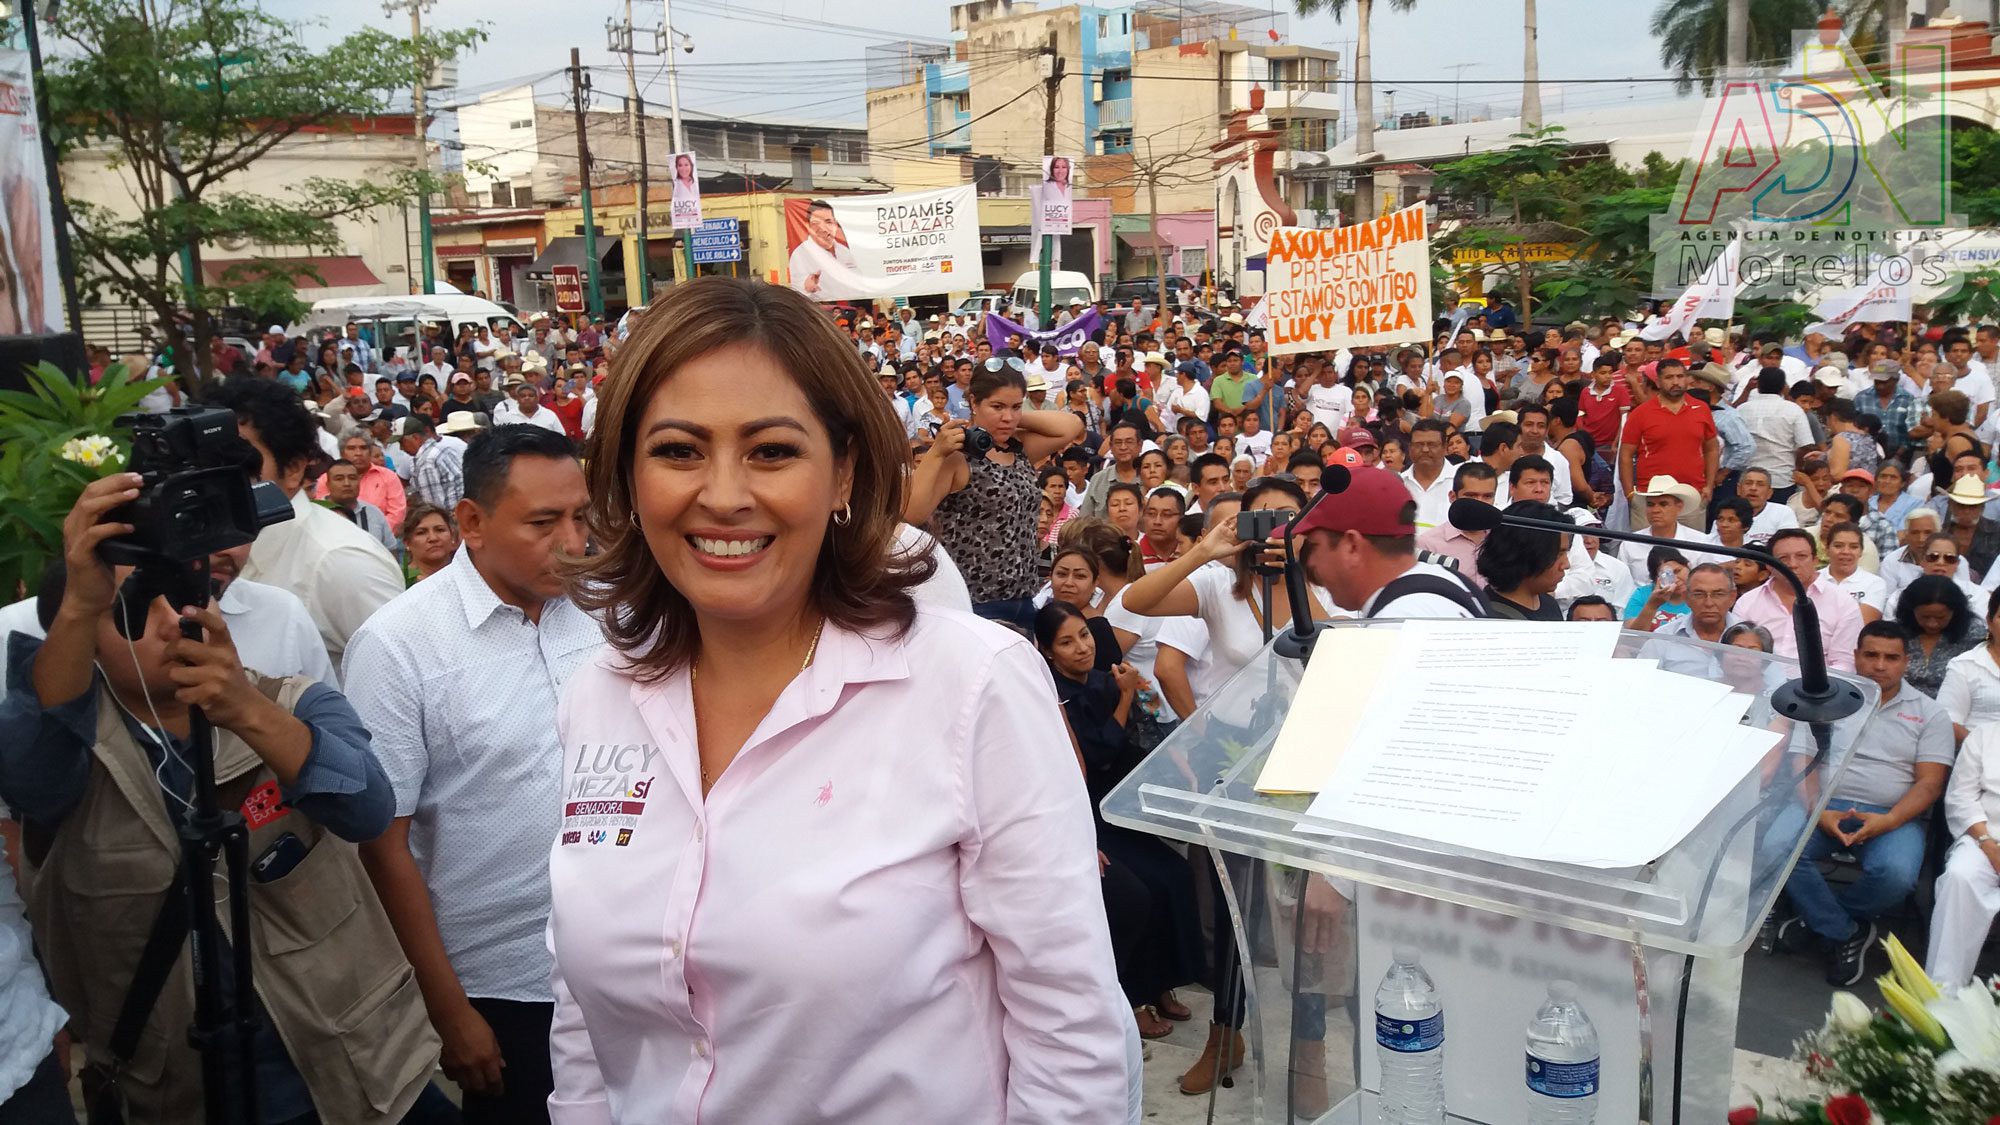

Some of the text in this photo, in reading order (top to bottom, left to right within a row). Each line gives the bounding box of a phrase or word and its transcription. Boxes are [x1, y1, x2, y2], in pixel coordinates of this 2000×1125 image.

[674, 200, 697, 209] LUCY
[877, 199, 954, 221] RADAMÉS
[1045, 205, 1069, 213] LUCY
[878, 216, 954, 235] SALAZAR
[886, 233, 946, 249] SENADOR
[1266, 208, 1424, 264] AXOCHIAPAN
[1291, 246, 1396, 288] PRESENTE
[555, 275, 577, 286] RUTA
[557, 291, 580, 303] 2010
[1268, 271, 1417, 319] ESTAMOS CONTIGO
[1274, 313, 1335, 344] LUCY
[1348, 302, 1416, 336] MEZA
[203, 426, 222, 435] SONY
[574, 744, 660, 774] LUCY
[575, 802, 623, 815] SENADORA
